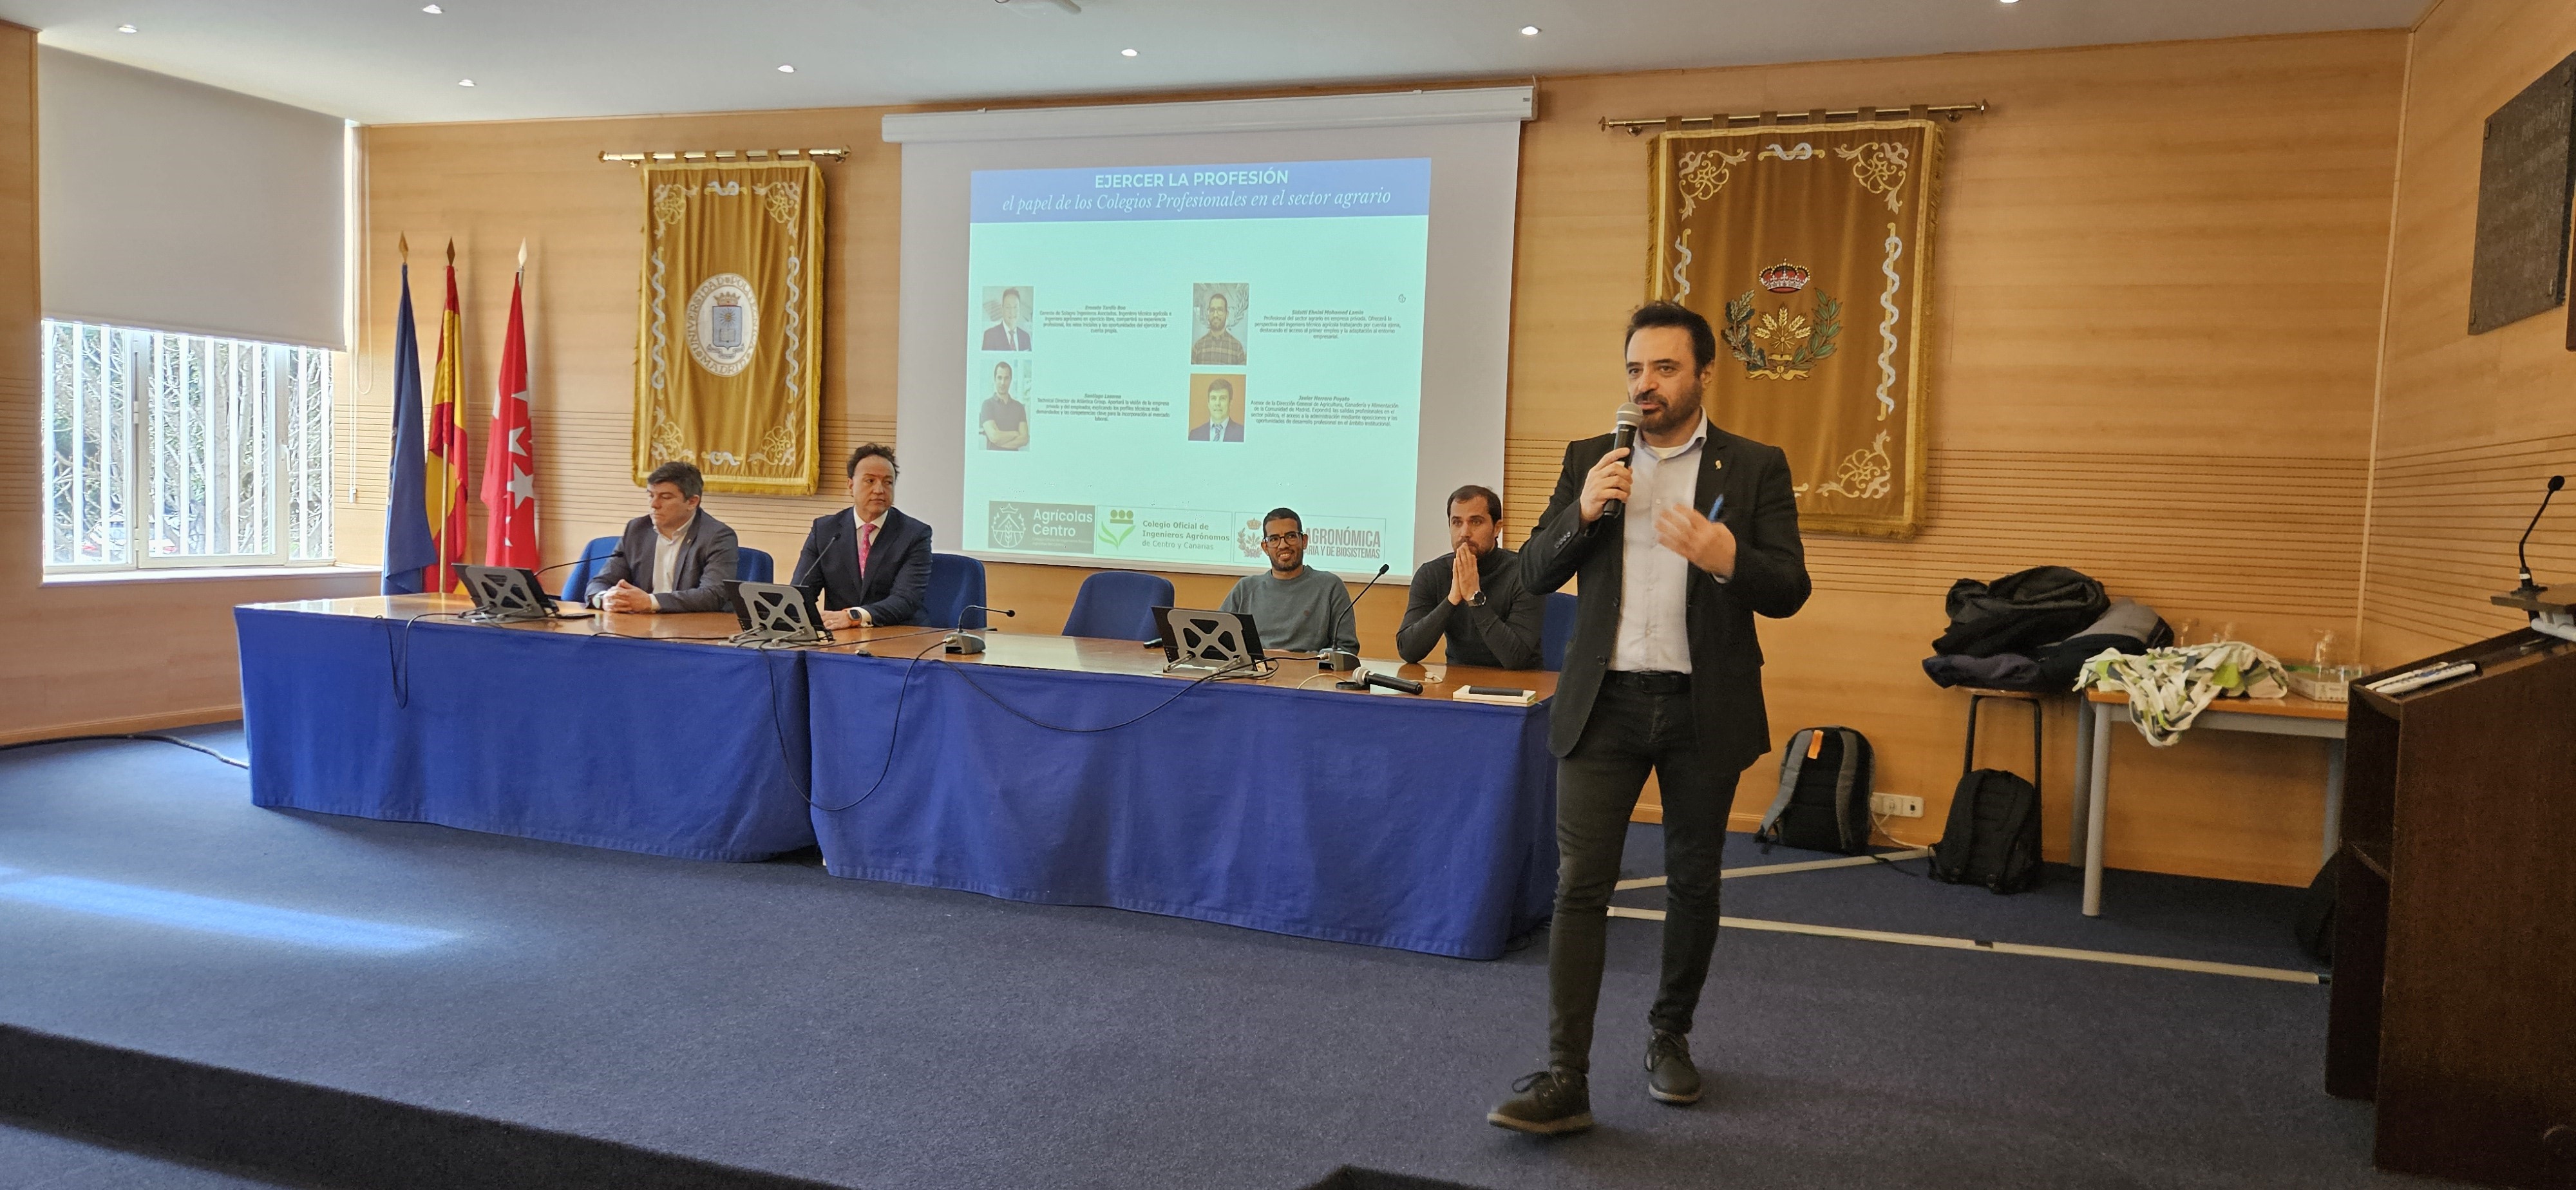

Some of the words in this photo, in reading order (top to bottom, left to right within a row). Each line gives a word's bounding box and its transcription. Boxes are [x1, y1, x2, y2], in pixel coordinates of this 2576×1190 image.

[1095, 173, 1164, 188] EJERCER
[1169, 173, 1189, 187] LA
[1194, 167, 1288, 186] PROFESIÓN
[1003, 195, 1014, 211] el
[1016, 194, 1053, 214] papel
[1056, 194, 1071, 210] de
[1075, 194, 1092, 209] los
[1097, 193, 1152, 213] Colegios
[1155, 191, 1246, 212] Profesionales
[1251, 195, 1268, 207] en
[1272, 190, 1285, 206] el
[1288, 193, 1331, 206] sector
[1334, 187, 1391, 209] agrario
[699, 355, 747, 374] MADRID
[1032, 509, 1094, 524] Agrícolas
[1032, 524, 1076, 538] Centro
[1142, 520, 1171, 529] Colegio
[1173, 521, 1197, 530] Oficial
[1142, 530, 1183, 540] Ingenieros
[1186, 531, 1230, 542] Agrónomos
[1305, 526, 1381, 547] AGRONÓMICA
[1152, 540, 1175, 549] Centro
[1183, 542, 1214, 550] Canarias
[1321, 545, 1325, 556] Y
[1327, 546, 1335, 556] DE
[1336, 546, 1381, 559] BIOSISTEMAS
